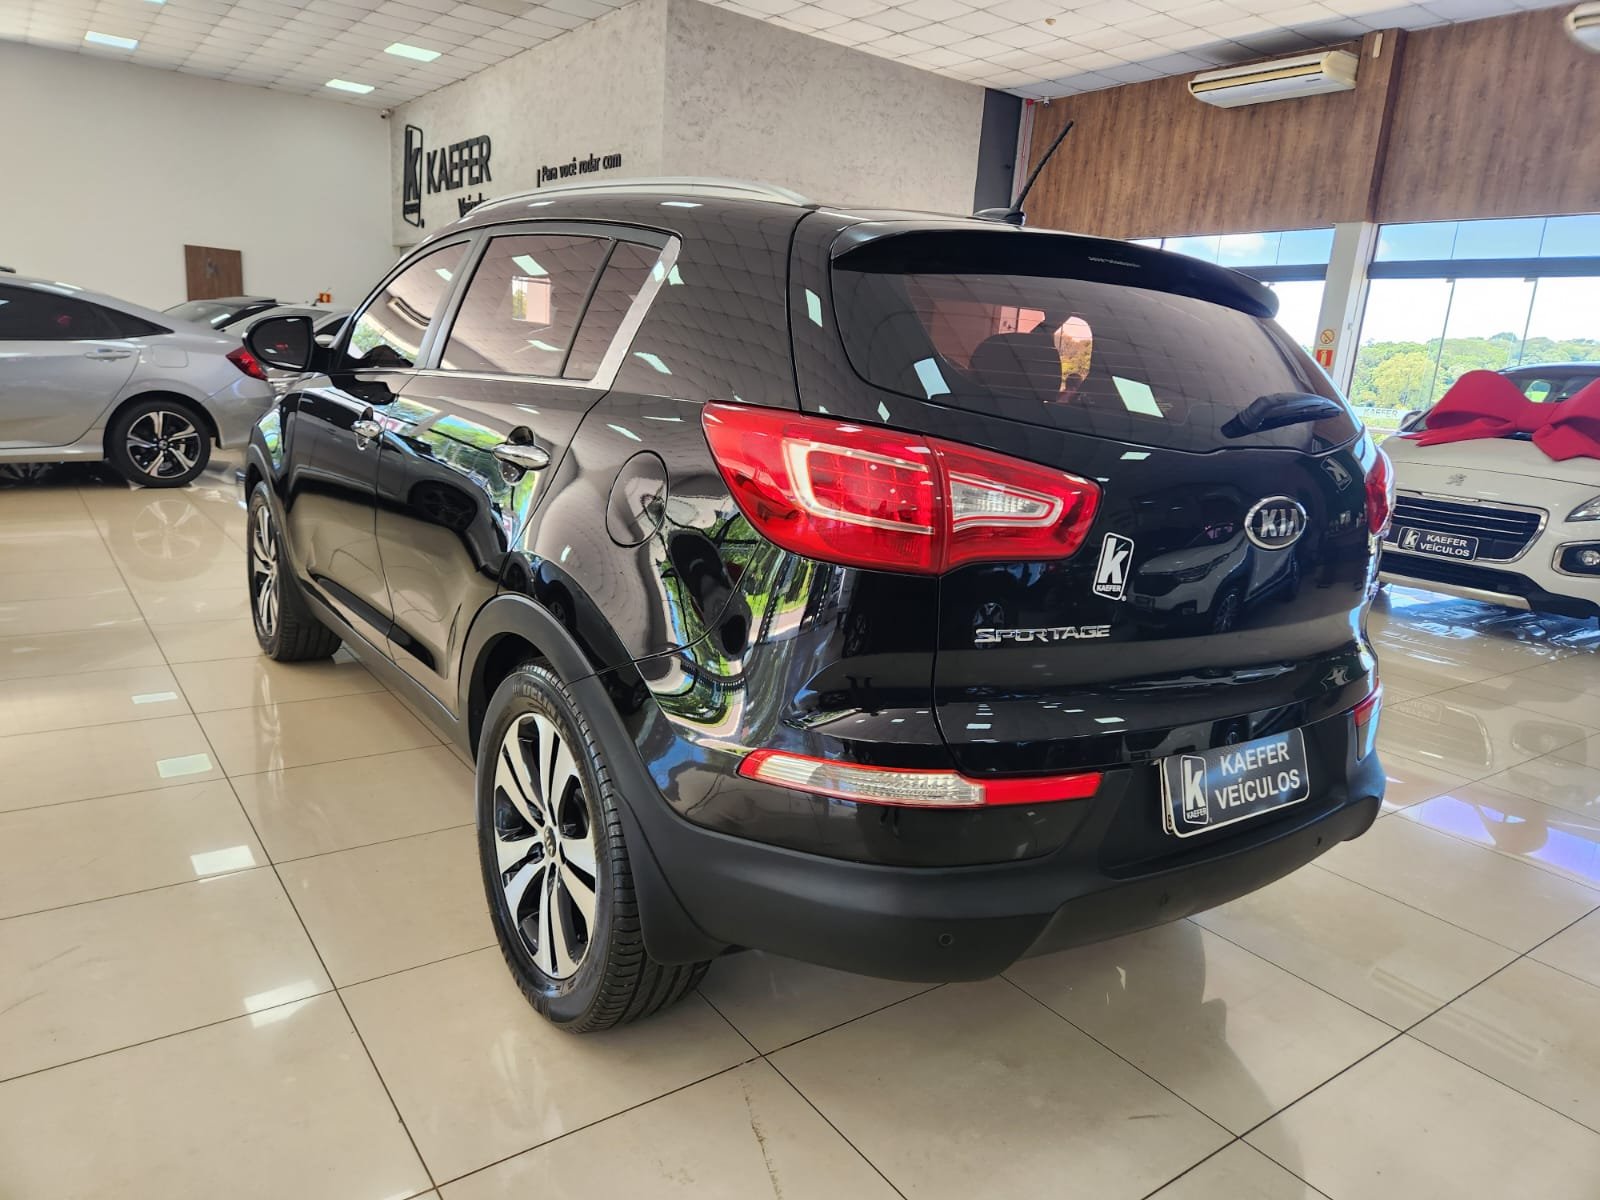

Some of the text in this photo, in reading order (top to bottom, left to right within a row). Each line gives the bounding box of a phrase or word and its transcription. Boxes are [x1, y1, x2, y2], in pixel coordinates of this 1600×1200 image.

[427, 135, 492, 194] KAEFER
[542, 153, 621, 181] Para você rodar com
[1260, 508, 1300, 538] KIA
[1420, 542, 1471, 557] VEÍCULOS
[1426, 534, 1468, 548] KAEFER
[1096, 584, 1122, 592] KAEFER
[974, 624, 1112, 643] SPORTAGE
[1220, 742, 1290, 776] KAEFER
[1214, 768, 1301, 810] VEÍCULOS
[1186, 807, 1207, 820] KAEFER
